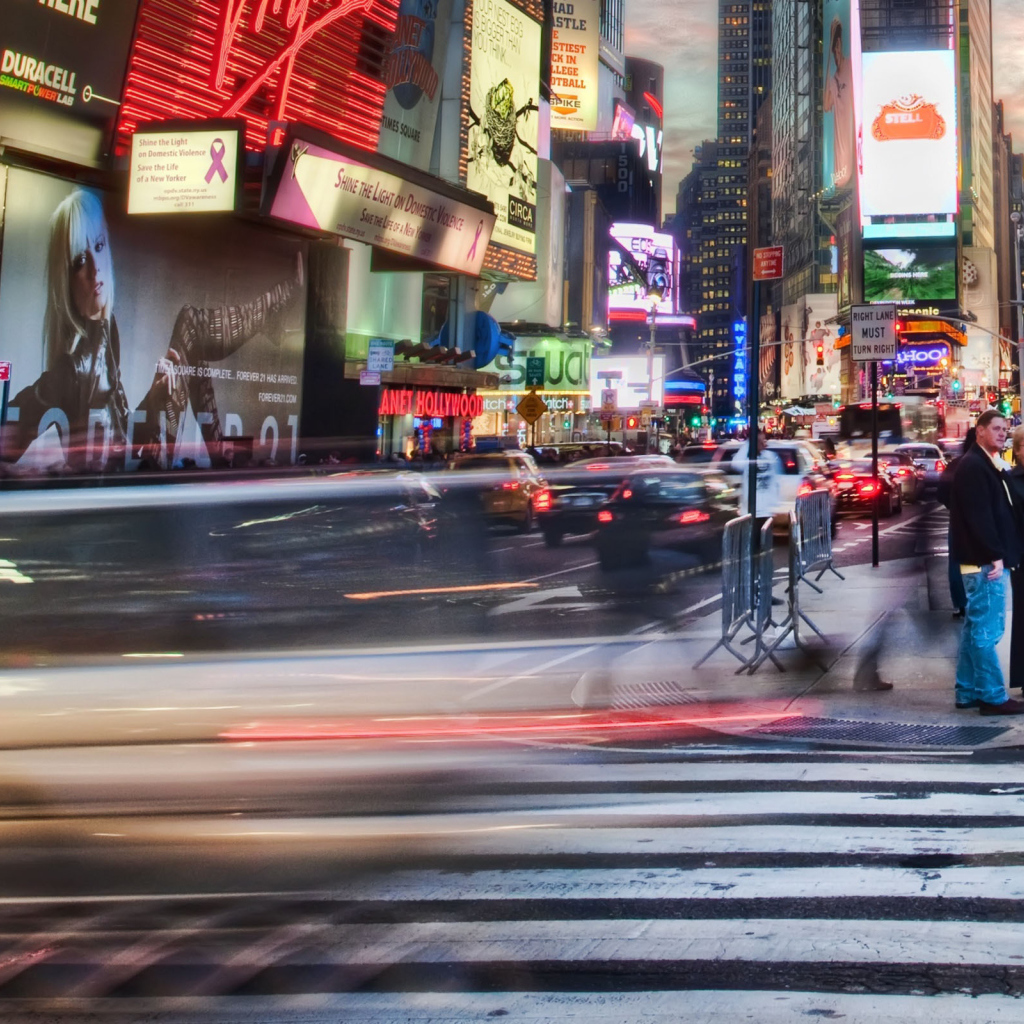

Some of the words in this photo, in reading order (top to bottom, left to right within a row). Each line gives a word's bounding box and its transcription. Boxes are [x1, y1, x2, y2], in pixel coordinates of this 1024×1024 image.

[552, 3, 574, 16] HAD
[552, 42, 586, 55] STIEST
[566, 55, 577, 65] IN
[1, 49, 77, 95] DURACELL
[550, 65, 579, 77] LLEGE
[550, 77, 586, 89] OTBALL
[56, 94, 75, 106] LAB
[550, 98, 581, 108] SPIKE
[381, 114, 399, 134] TIMES
[400, 121, 421, 143] SQUARE
[139, 139, 157, 147] Shine
[158, 138, 169, 146] the
[171, 138, 188, 147] Light
[179, 149, 206, 157] Violence
[166, 163, 179, 171] Life
[137, 175, 143, 183] of
[509, 200, 533, 223] CIRCA
[853, 312, 873, 321] RIGHT
[876, 311, 894, 321] LANE
[862, 327, 885, 339] MUST
[854, 345, 871, 354] TURN
[873, 344, 895, 354] RIGHT
[173, 365, 196, 377] SQUARE
[197, 367, 203, 377] IS
[236, 370, 259, 381] FOREVER
[260, 372, 266, 382] 21
[267, 373, 276, 383] HAS
[258, 392, 298, 404] FOREVER21.COM
[378, 389, 414, 415] ANET
[414, 389, 484, 417] HOLLYWOOD
